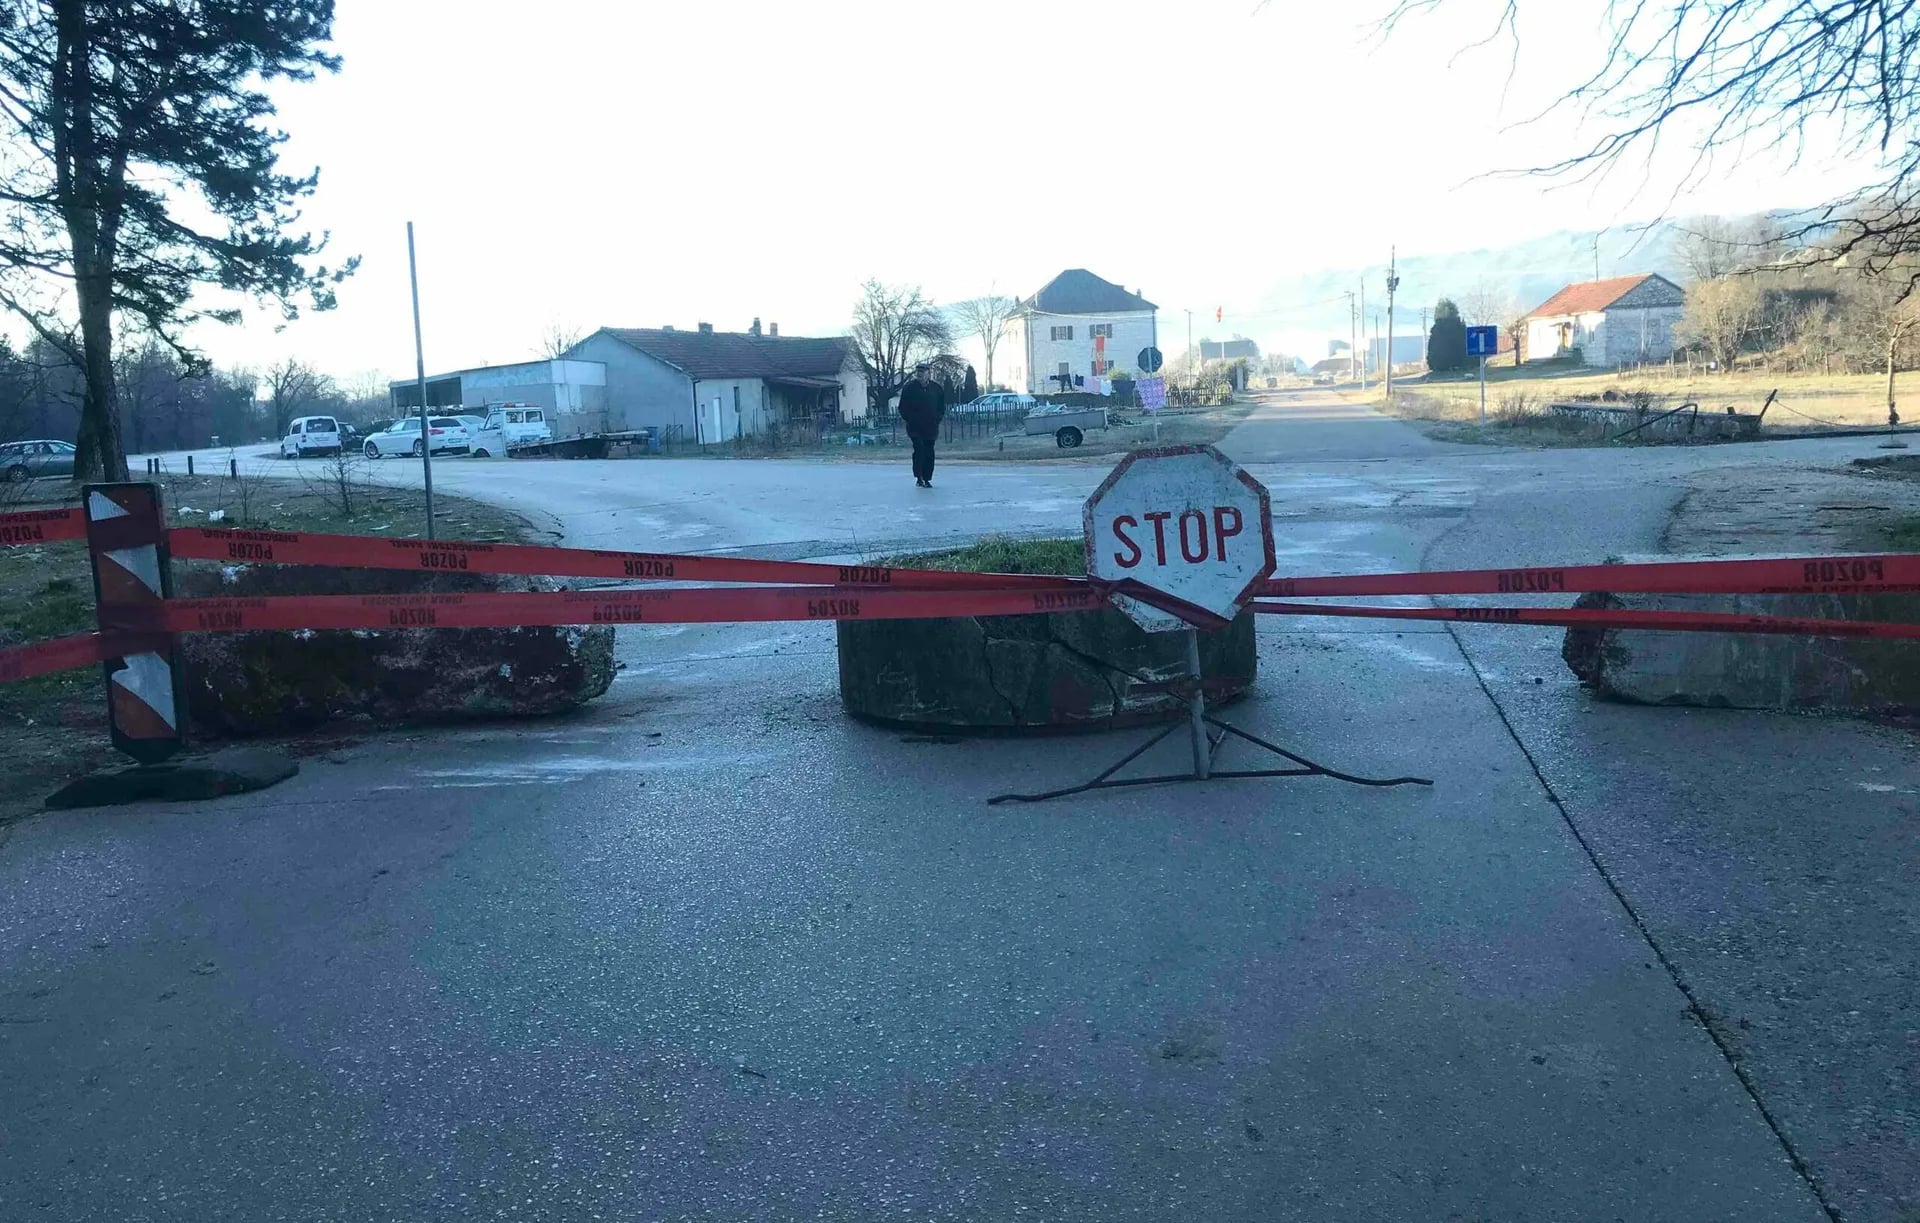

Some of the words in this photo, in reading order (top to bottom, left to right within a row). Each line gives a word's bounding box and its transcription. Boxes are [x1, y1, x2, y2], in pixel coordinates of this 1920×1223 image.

[0, 525, 43, 543] POZO
[1112, 506, 1243, 568] STOP
[228, 542, 273, 560] POZOR
[420, 552, 468, 570] POZOR
[623, 560, 674, 577] POZOR
[839, 567, 891, 583] POZOR
